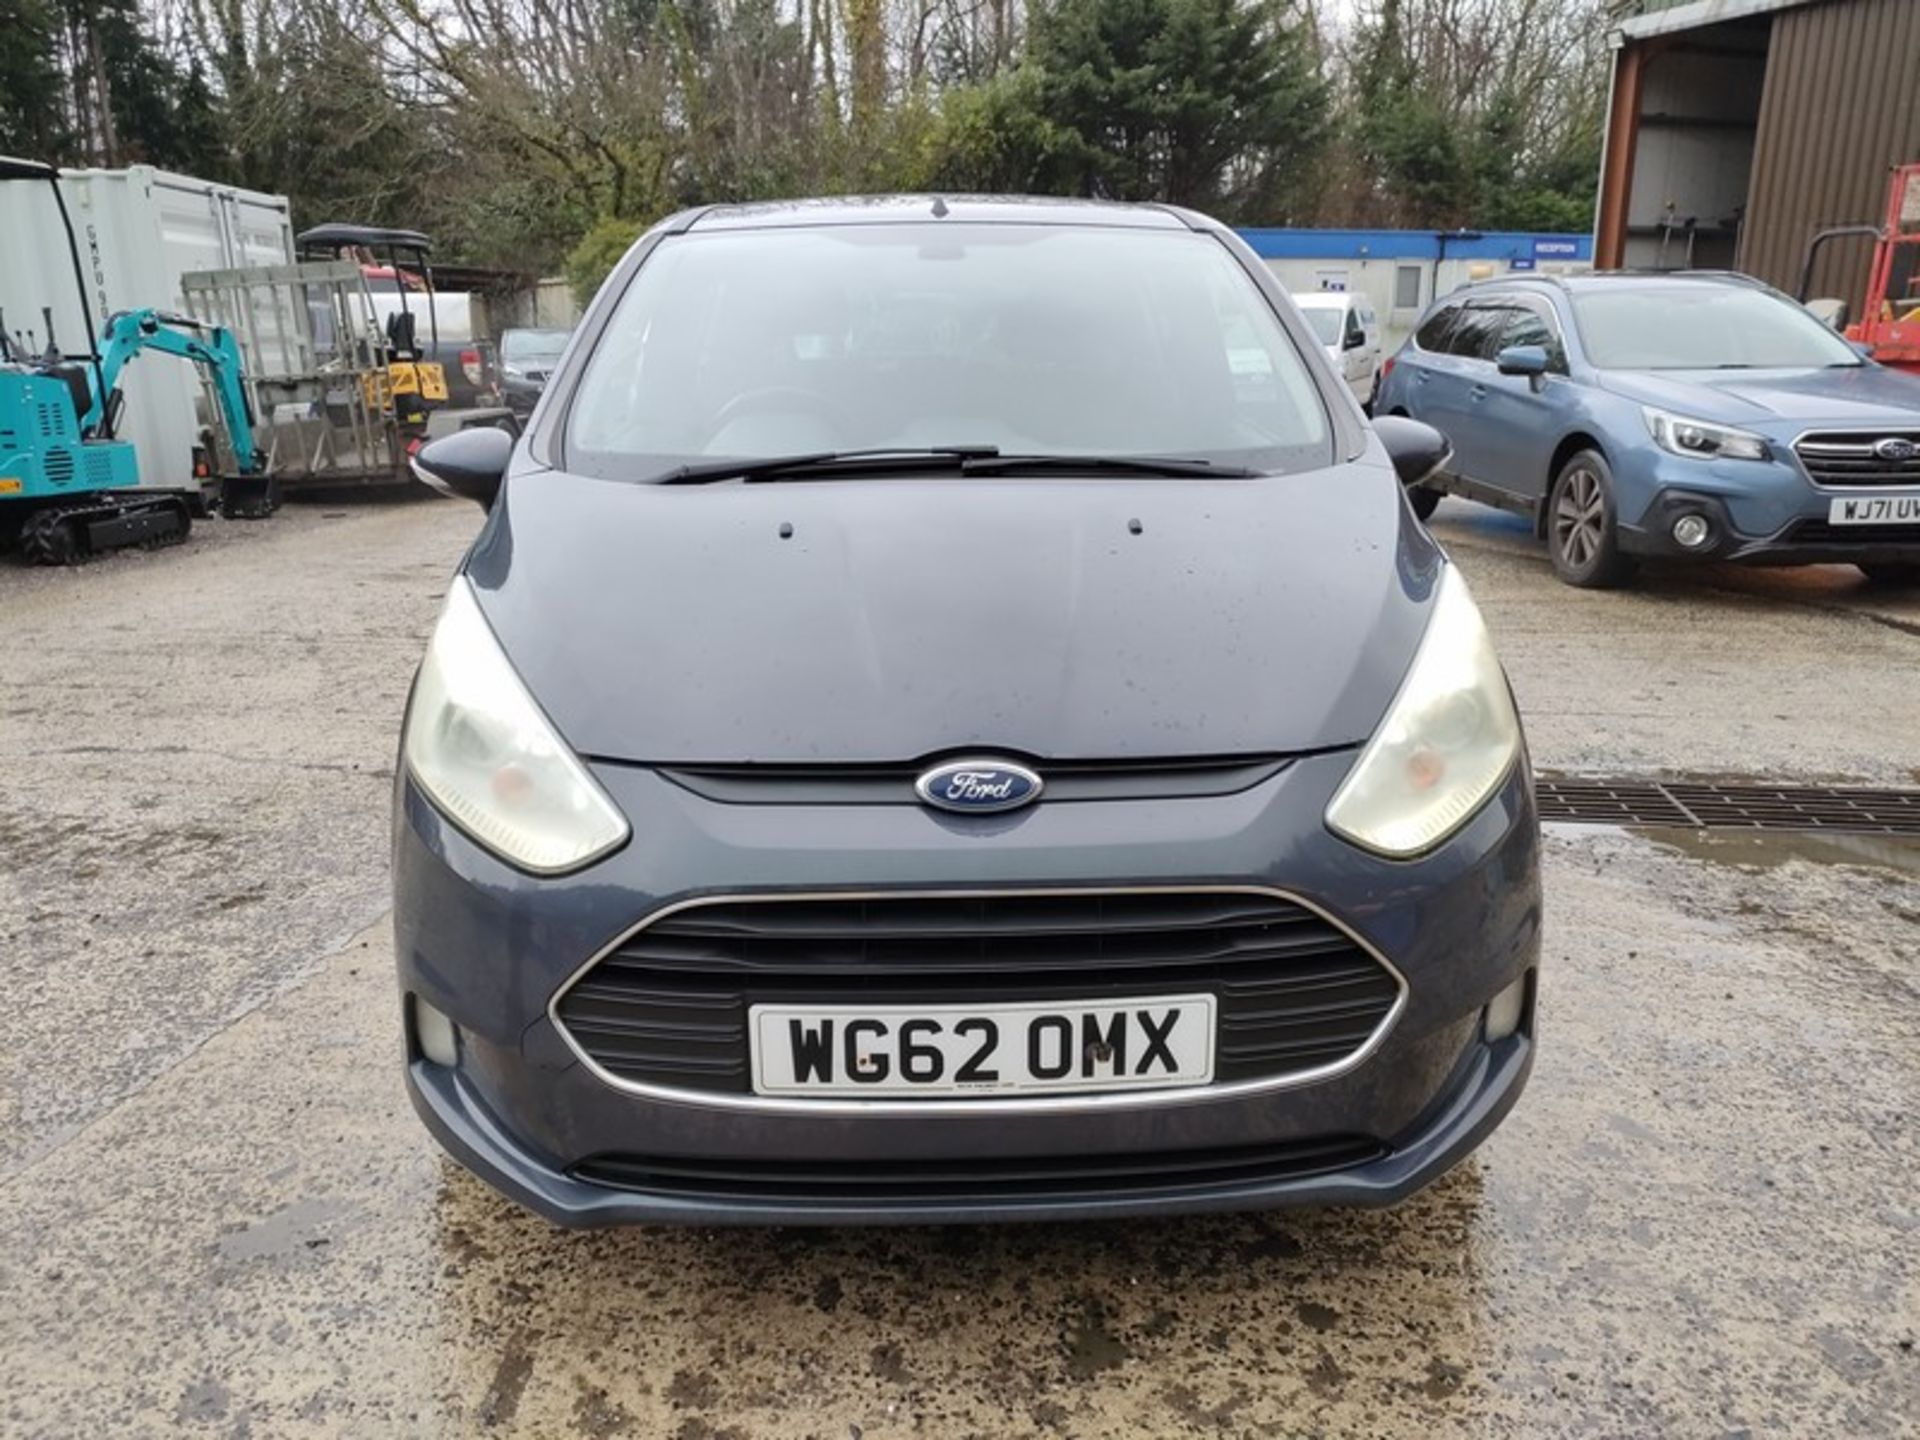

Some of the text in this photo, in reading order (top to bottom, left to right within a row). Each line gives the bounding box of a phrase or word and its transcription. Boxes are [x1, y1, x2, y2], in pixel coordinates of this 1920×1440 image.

[1844, 500, 1892, 519] WJ71
[946, 771, 1014, 799] Ford
[788, 1008, 1181, 1084] WG62 OMX
